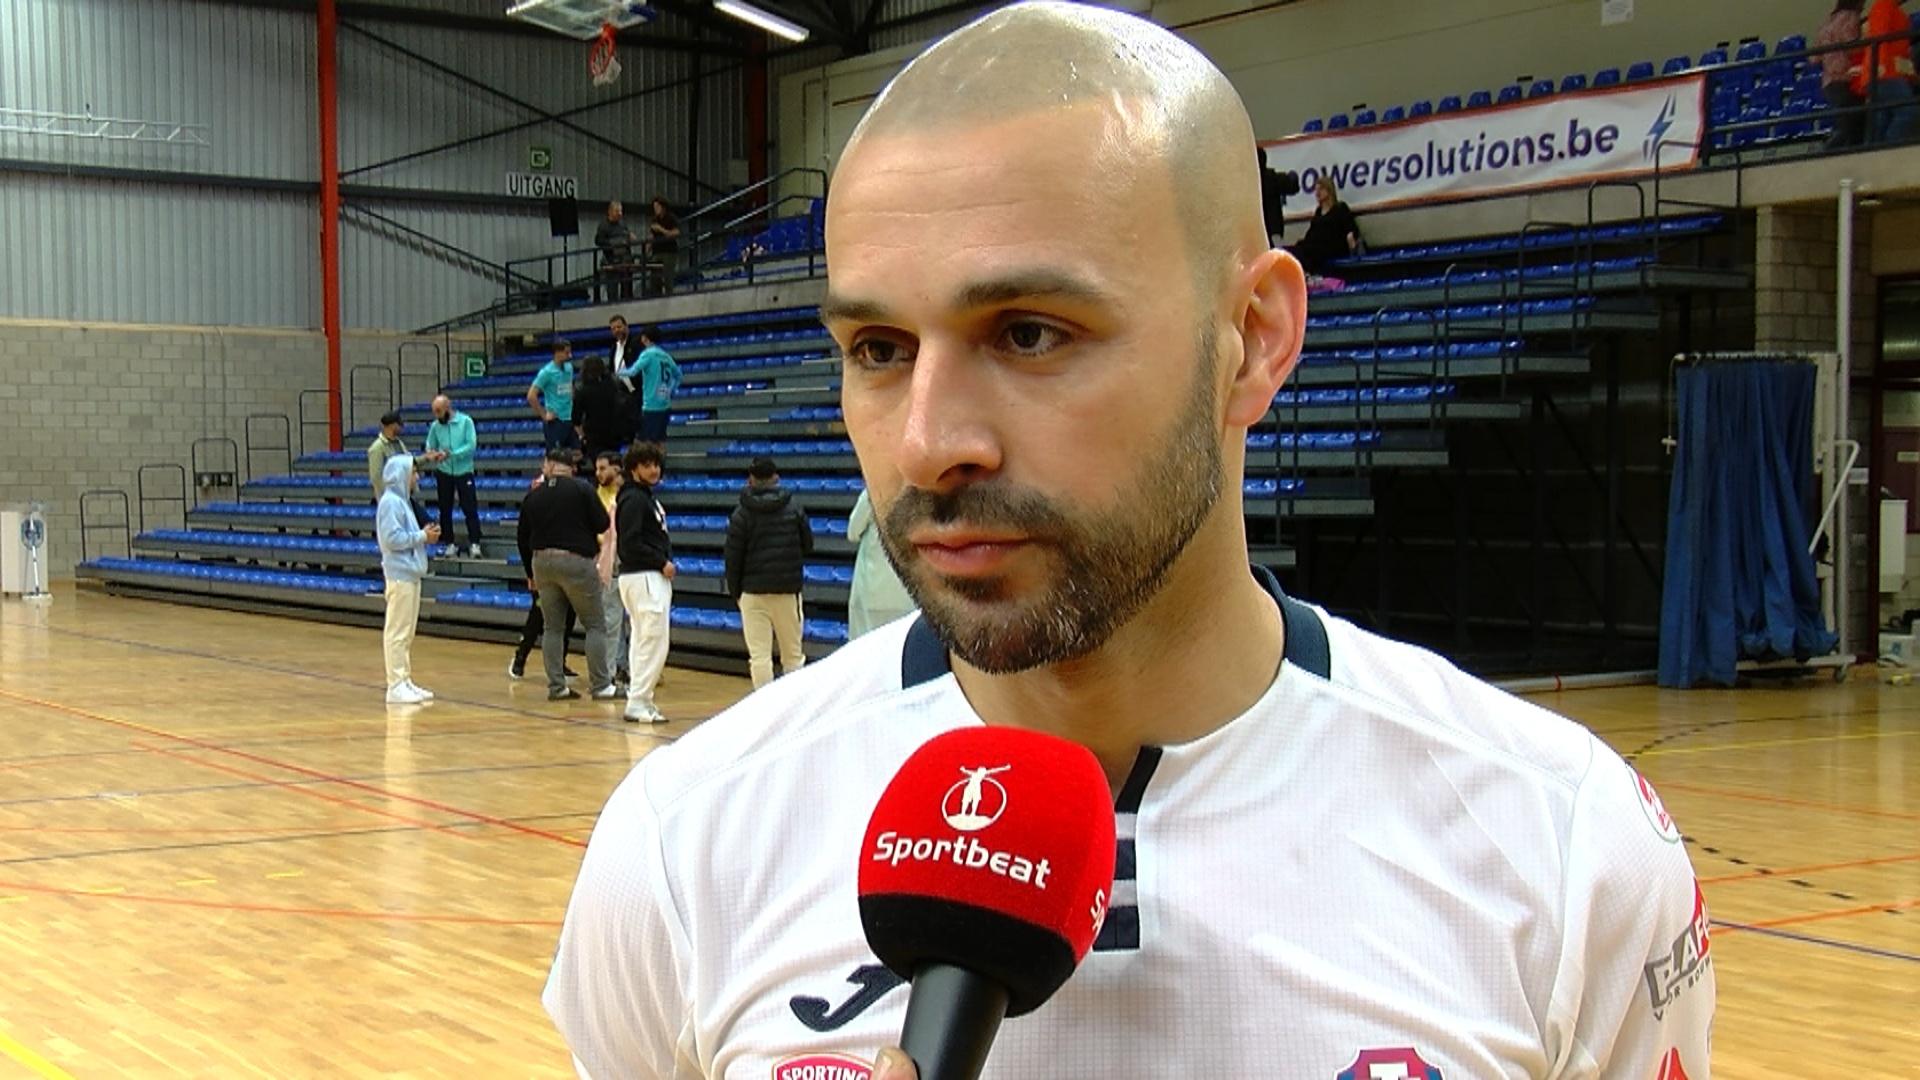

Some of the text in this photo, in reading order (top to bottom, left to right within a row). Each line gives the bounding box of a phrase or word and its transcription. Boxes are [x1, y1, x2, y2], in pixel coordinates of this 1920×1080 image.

[1288, 118, 1620, 194] owersolutions.be
[509, 175, 575, 198] UITGANG
[873, 831, 1051, 889] Sportbeat
